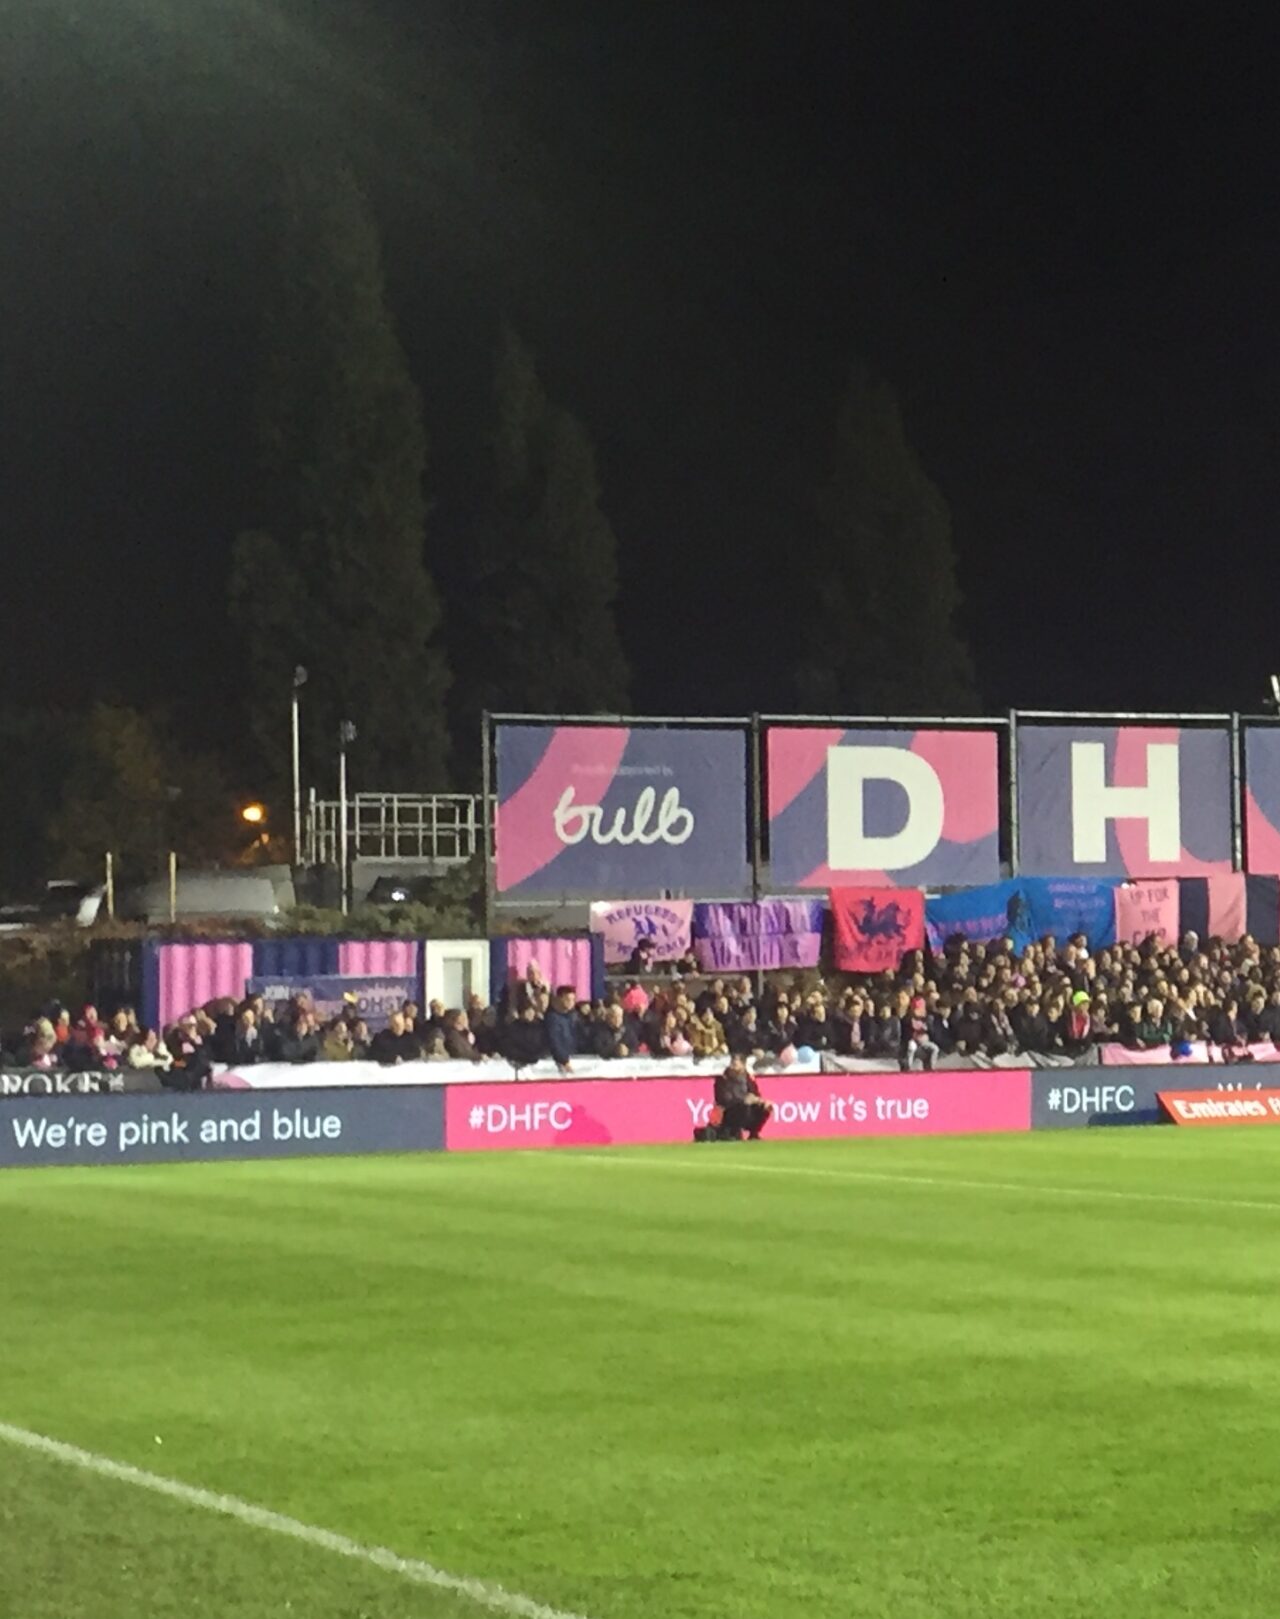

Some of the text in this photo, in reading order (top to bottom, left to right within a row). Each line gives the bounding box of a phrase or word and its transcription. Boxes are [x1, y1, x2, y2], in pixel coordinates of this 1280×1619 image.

[553, 786, 694, 845] bulb
[829, 1093, 867, 1121] it's
[875, 1096, 929, 1120] true
[1048, 1085, 1135, 1113] #DHFC
[1172, 1098, 1268, 1119] Emirates
[12, 1109, 342, 1152] We're pink and blue
[469, 1101, 572, 1134] #DHFC
